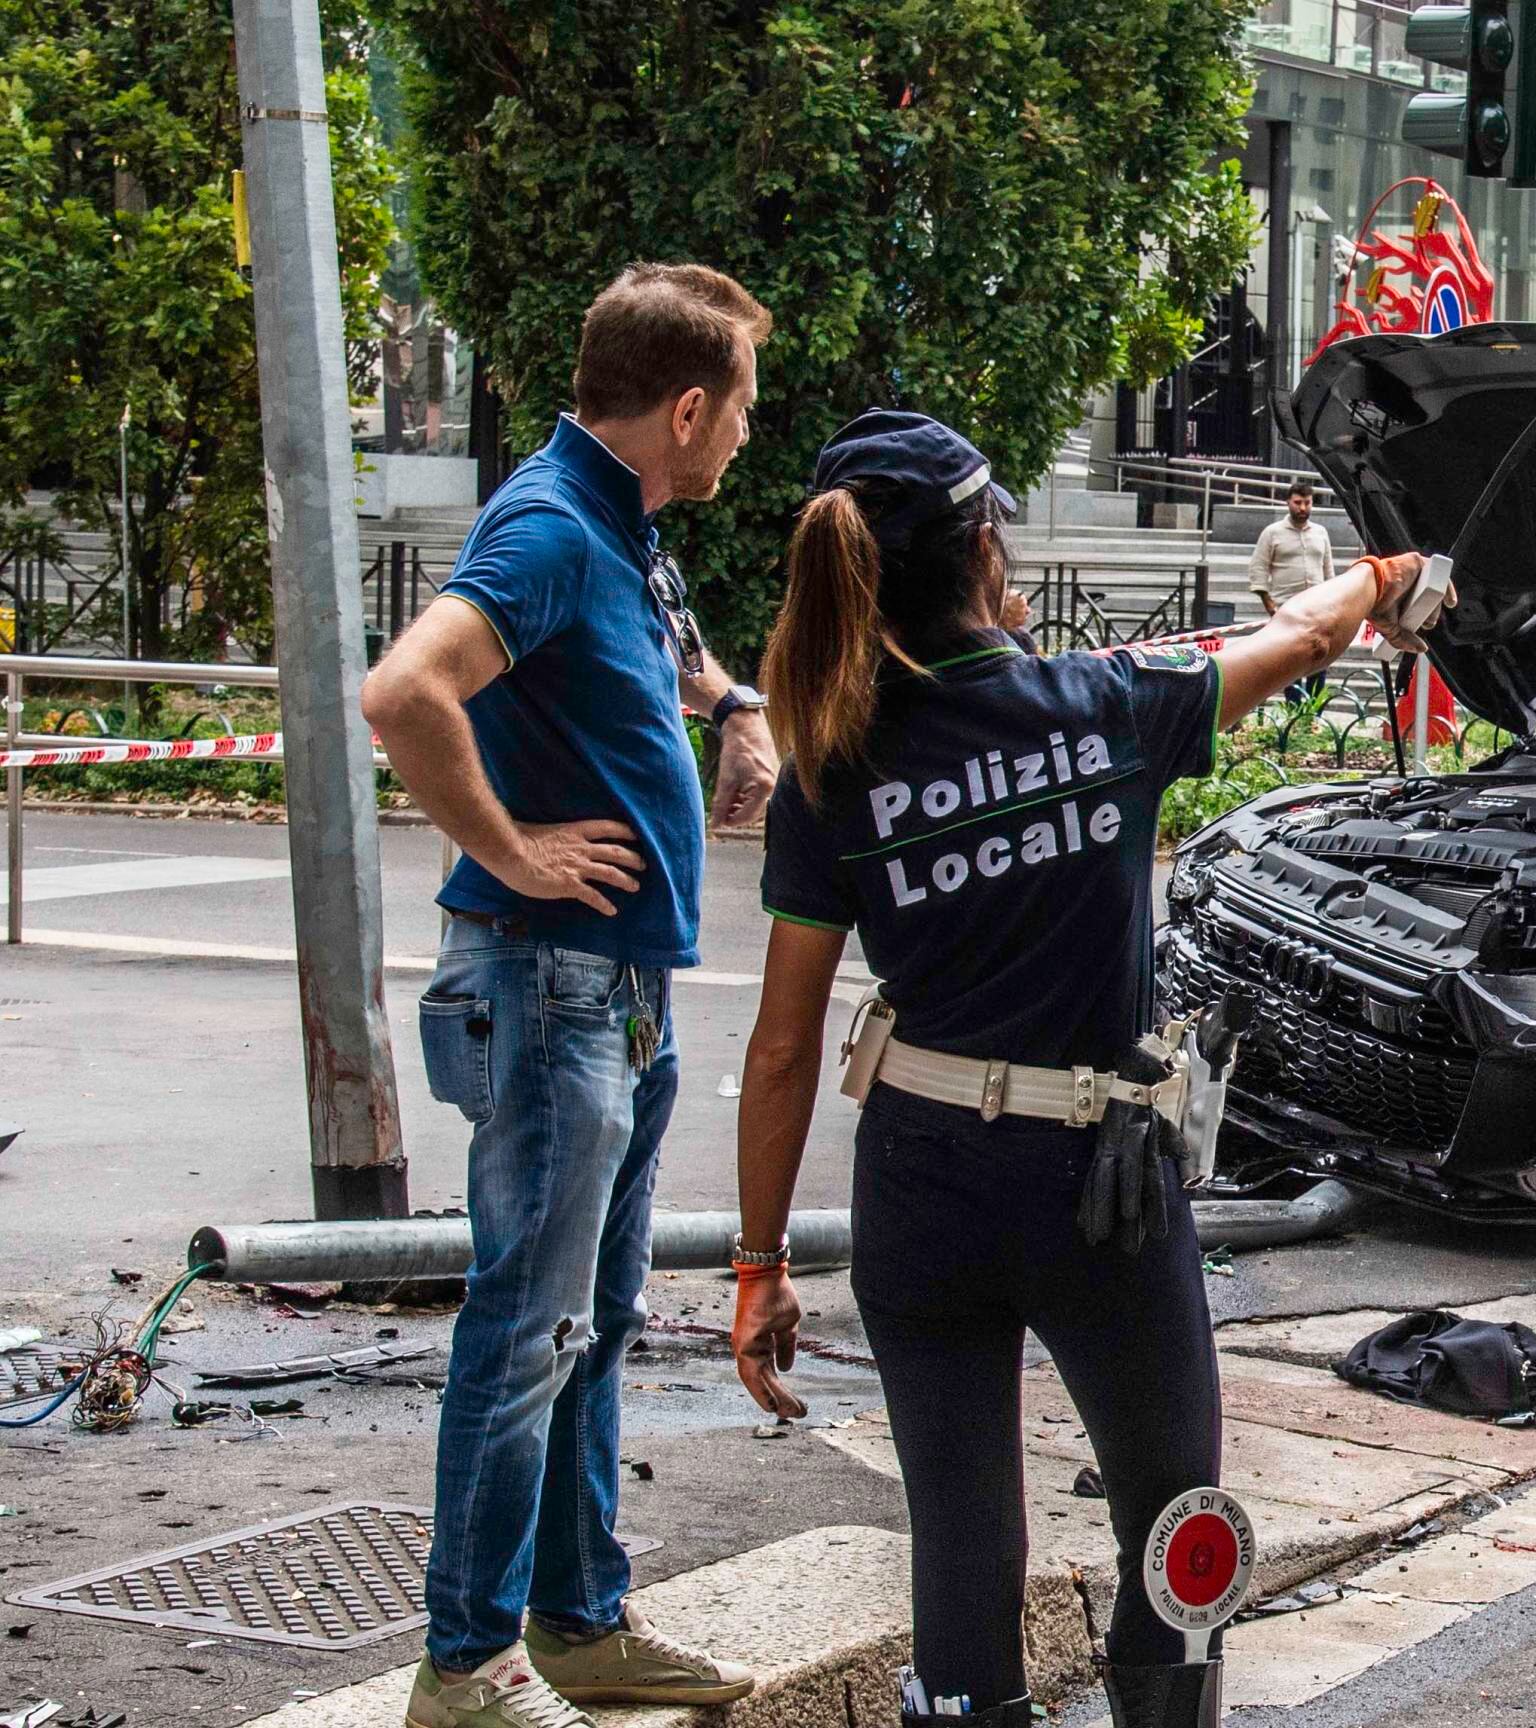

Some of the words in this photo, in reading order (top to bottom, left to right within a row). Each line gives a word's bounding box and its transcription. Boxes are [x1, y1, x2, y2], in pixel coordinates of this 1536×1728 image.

[869, 731, 1113, 839] Polizia
[885, 801, 1122, 908] Locale
[1152, 1500, 1192, 1572] COMUNE
[1200, 1495, 1214, 1511] DI
[1220, 1501, 1251, 1567] MILANO
[1159, 1588, 1185, 1619] POLIZIA
[1214, 1583, 1241, 1615] LOCALE
